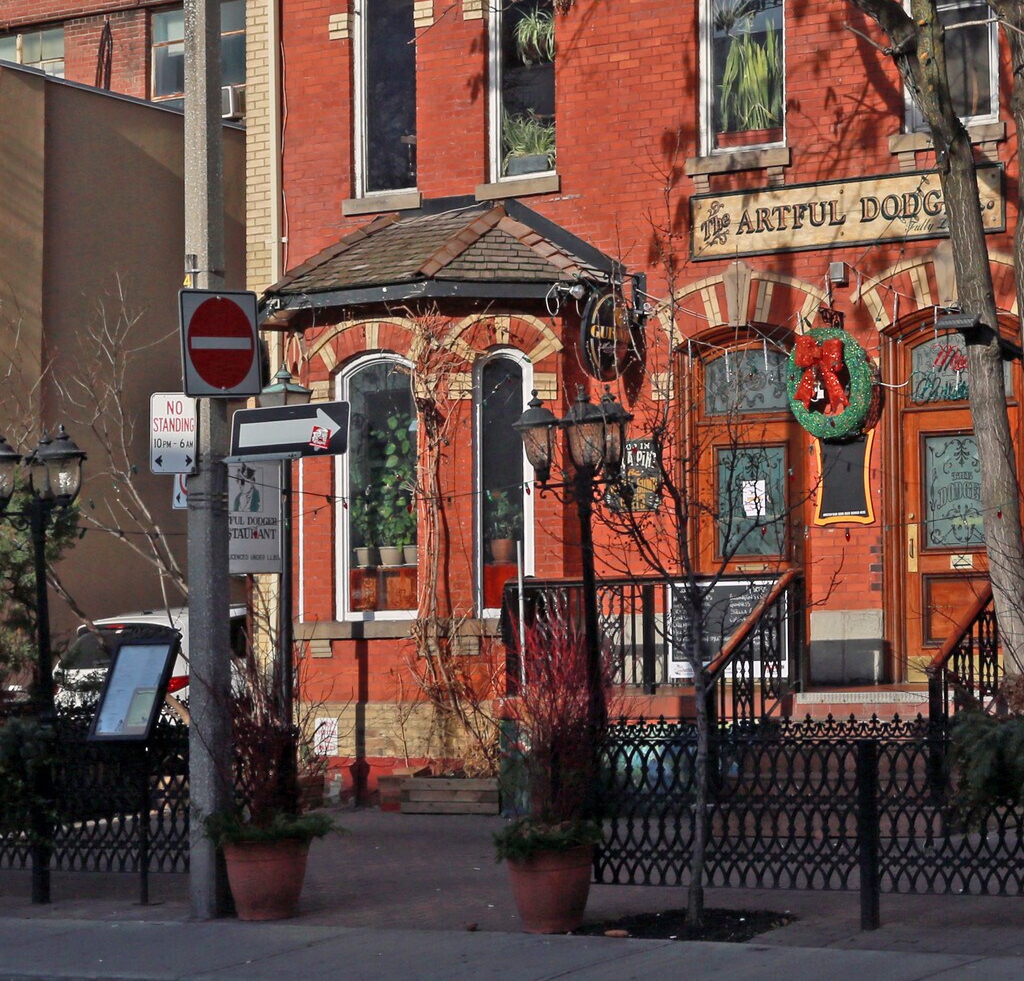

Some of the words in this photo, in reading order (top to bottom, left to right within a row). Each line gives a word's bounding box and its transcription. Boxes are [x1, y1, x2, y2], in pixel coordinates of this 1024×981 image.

[700, 212, 731, 242] The
[736, 199, 846, 235] ARTFUL
[859, 189, 946, 224] DODG
[905, 218, 934, 232] Fully
[166, 401, 183, 415] NO
[153, 418, 195, 432] STANDING
[247, 516, 278, 526] DODGER
